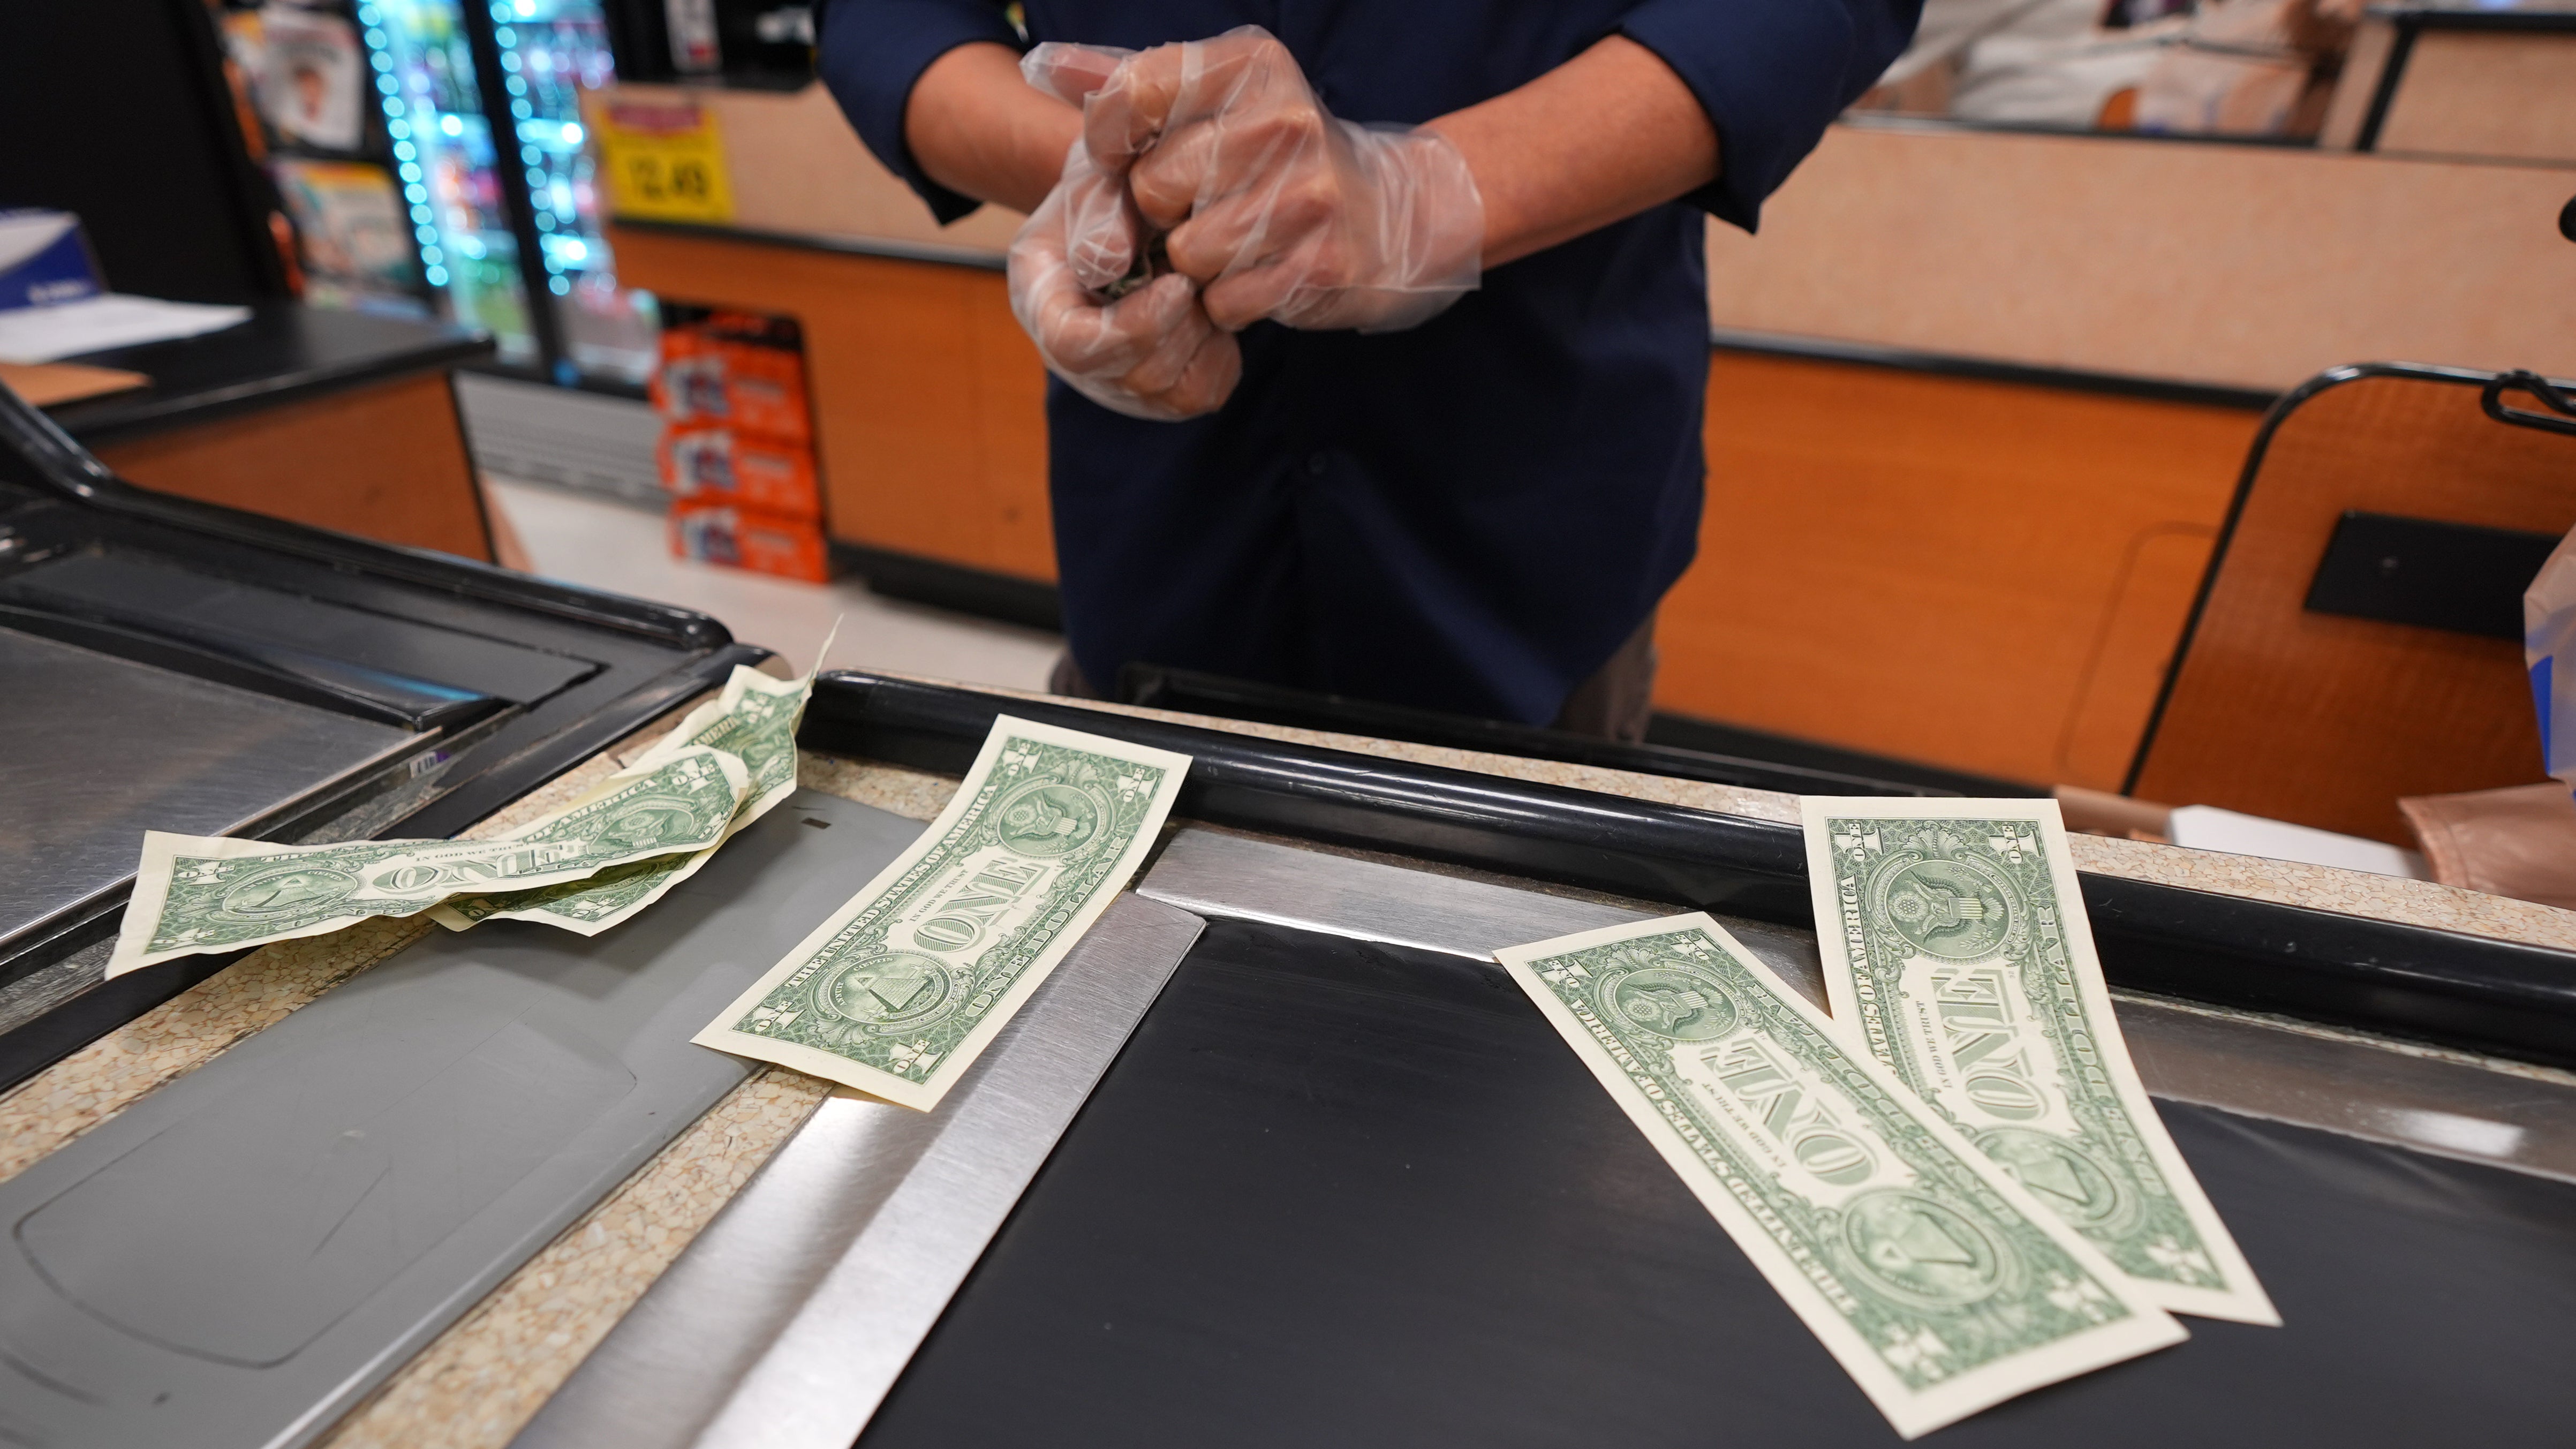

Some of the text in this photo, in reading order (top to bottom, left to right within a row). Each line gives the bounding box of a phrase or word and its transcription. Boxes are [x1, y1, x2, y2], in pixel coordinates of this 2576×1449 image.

[671, 763, 716, 786] ONE
[1007, 742, 1031, 776] ONE
[557, 779, 659, 827] AMERICA
[1122, 767, 1145, 803] ONE
[1848, 822, 1866, 862] ONE
[2001, 825, 2023, 864] ONE
[784, 783, 999, 988] THE UNITED STATES OF AMERICA
[909, 869, 968, 922] IN GOD WE TRUST
[912, 856, 1051, 953] ONE
[1025, 834, 1130, 955] DOLLAR
[1839, 873, 1872, 975] AMERICA
[1675, 933, 1710, 961] ONE
[1548, 959, 1581, 988] ONE
[1855, 971, 1878, 1002] OF
[754, 1000, 795, 1032] ONE
[1570, 997, 1648, 1073] AMERICA
[893, 1039, 931, 1074] ONE
[1915, 1000, 1954, 1089] IN GOD WE TRUST
[1930, 968, 2050, 1121] ONE
[1633, 1073, 1666, 1101] OF
[1699, 1037, 1880, 1186] ONE
[1659, 1100, 1734, 1177] STATES
